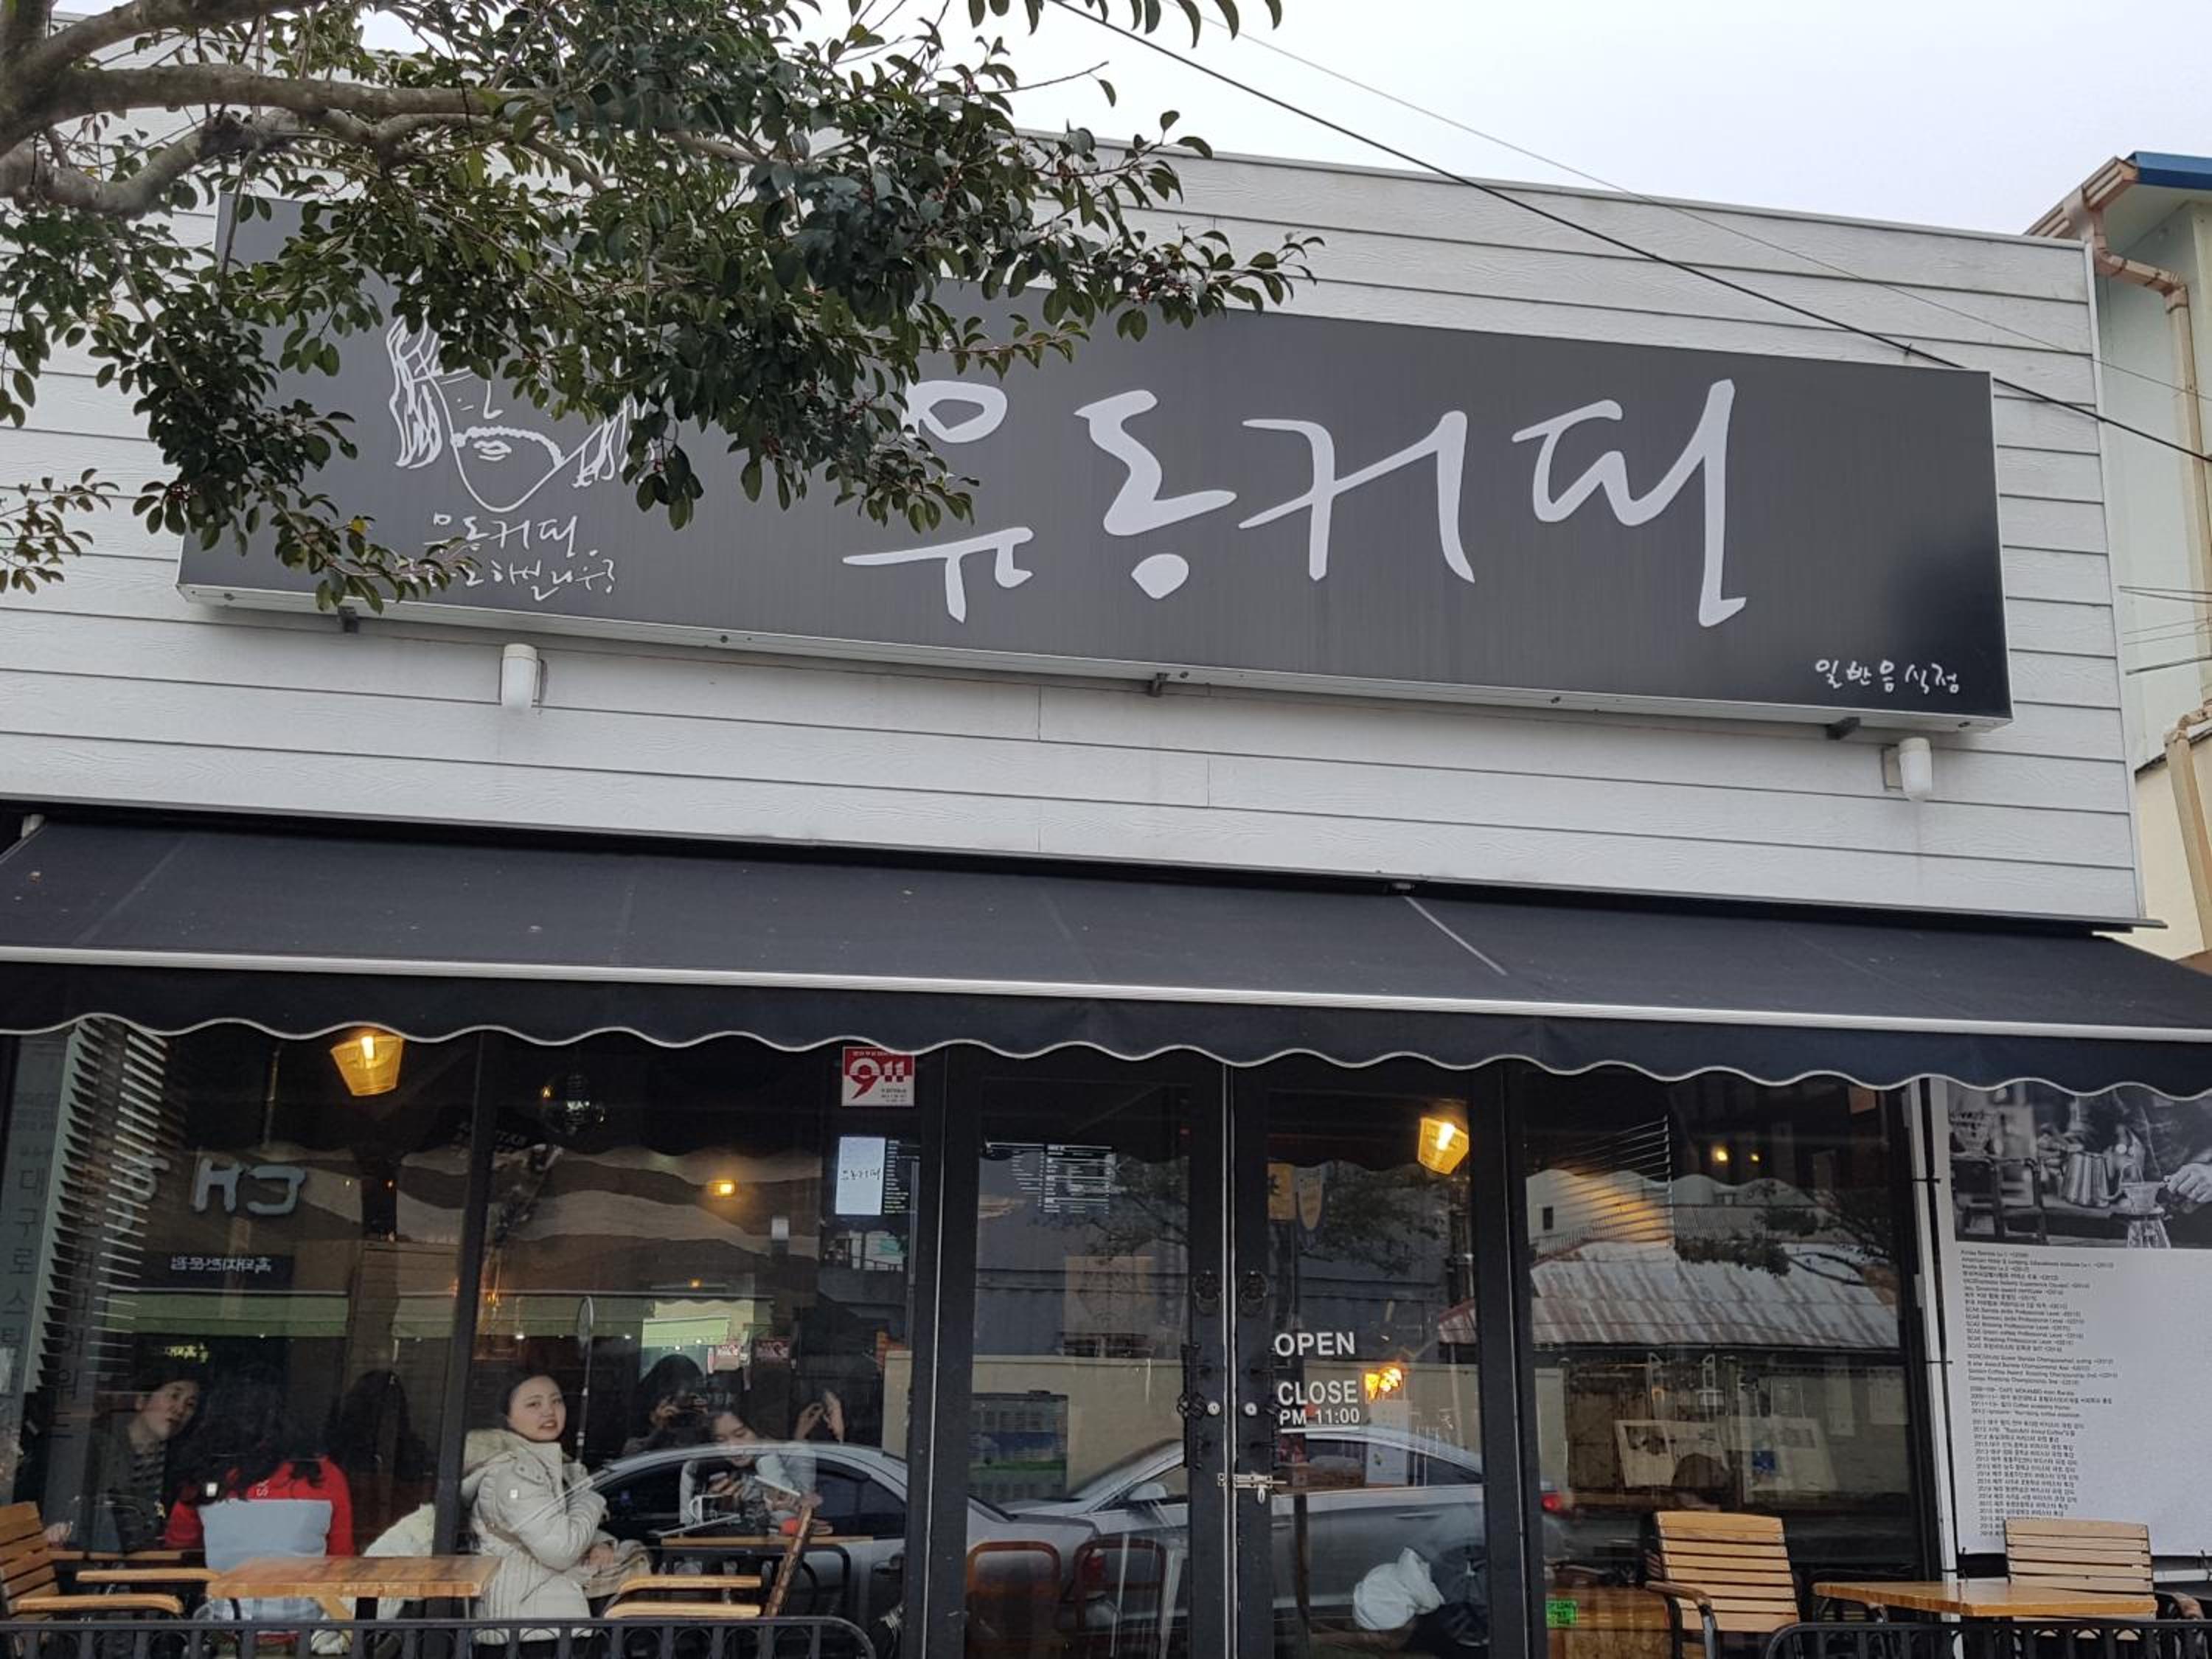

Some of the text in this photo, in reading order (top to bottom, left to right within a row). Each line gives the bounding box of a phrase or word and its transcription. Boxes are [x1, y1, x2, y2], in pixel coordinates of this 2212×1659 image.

[843, 378, 1747, 628] 유동커피
[1815, 659, 1959, 695] 일반음식점
[1274, 1332, 1355, 1357] OPEN
[1278, 1380, 1359, 1406] CLOSE
[1279, 1408, 1360, 1425] PM 11:00
